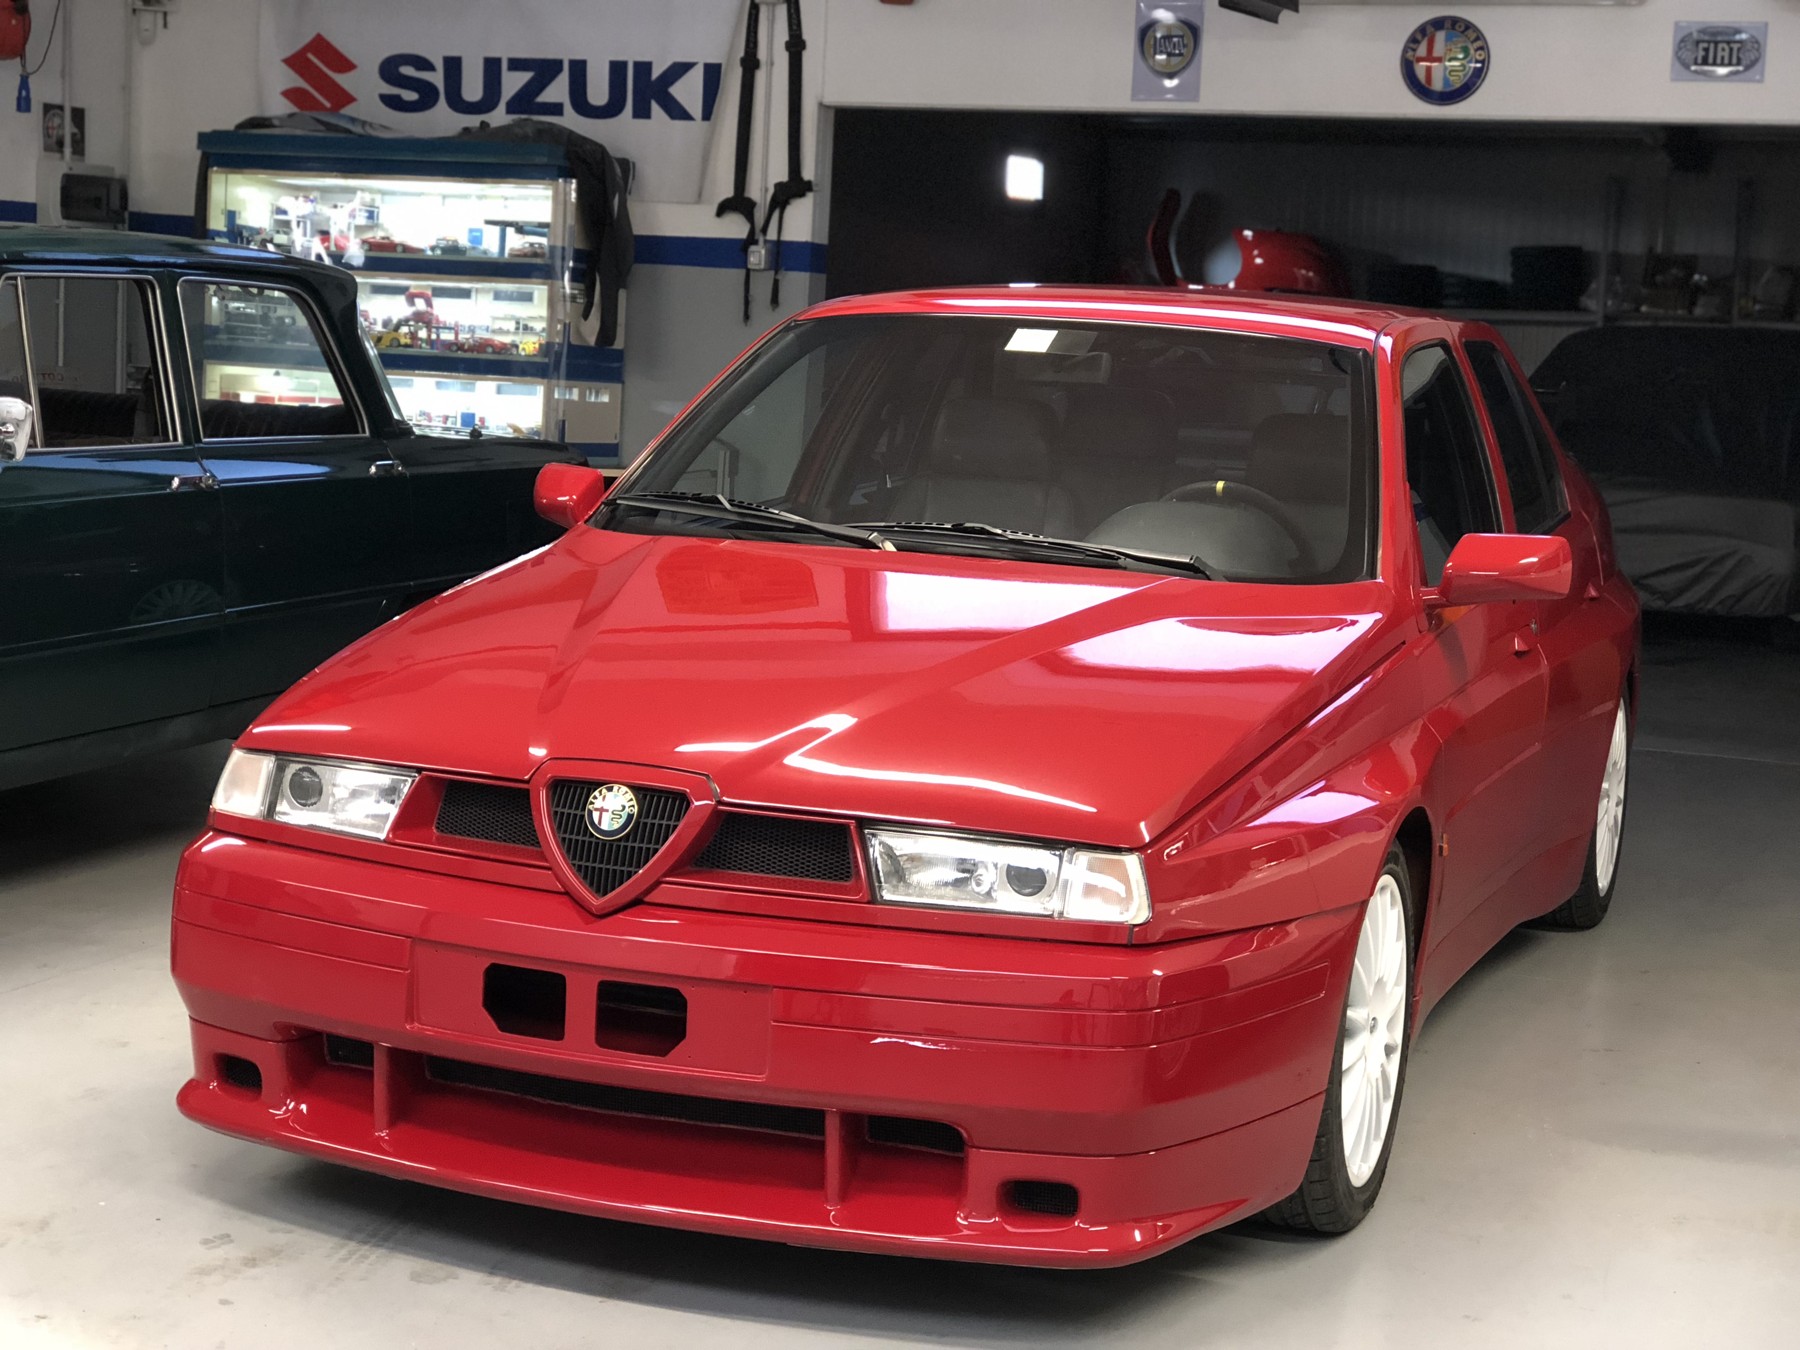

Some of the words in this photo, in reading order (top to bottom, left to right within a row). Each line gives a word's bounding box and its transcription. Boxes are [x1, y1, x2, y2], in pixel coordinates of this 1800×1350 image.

[1406, 24, 1436, 60] ALFA
[1444, 20, 1486, 61] ROMEO
[1697, 42, 1741, 65] FIAT
[378, 53, 722, 121] SUZUKI
[588, 788, 608, 811] ALFA
